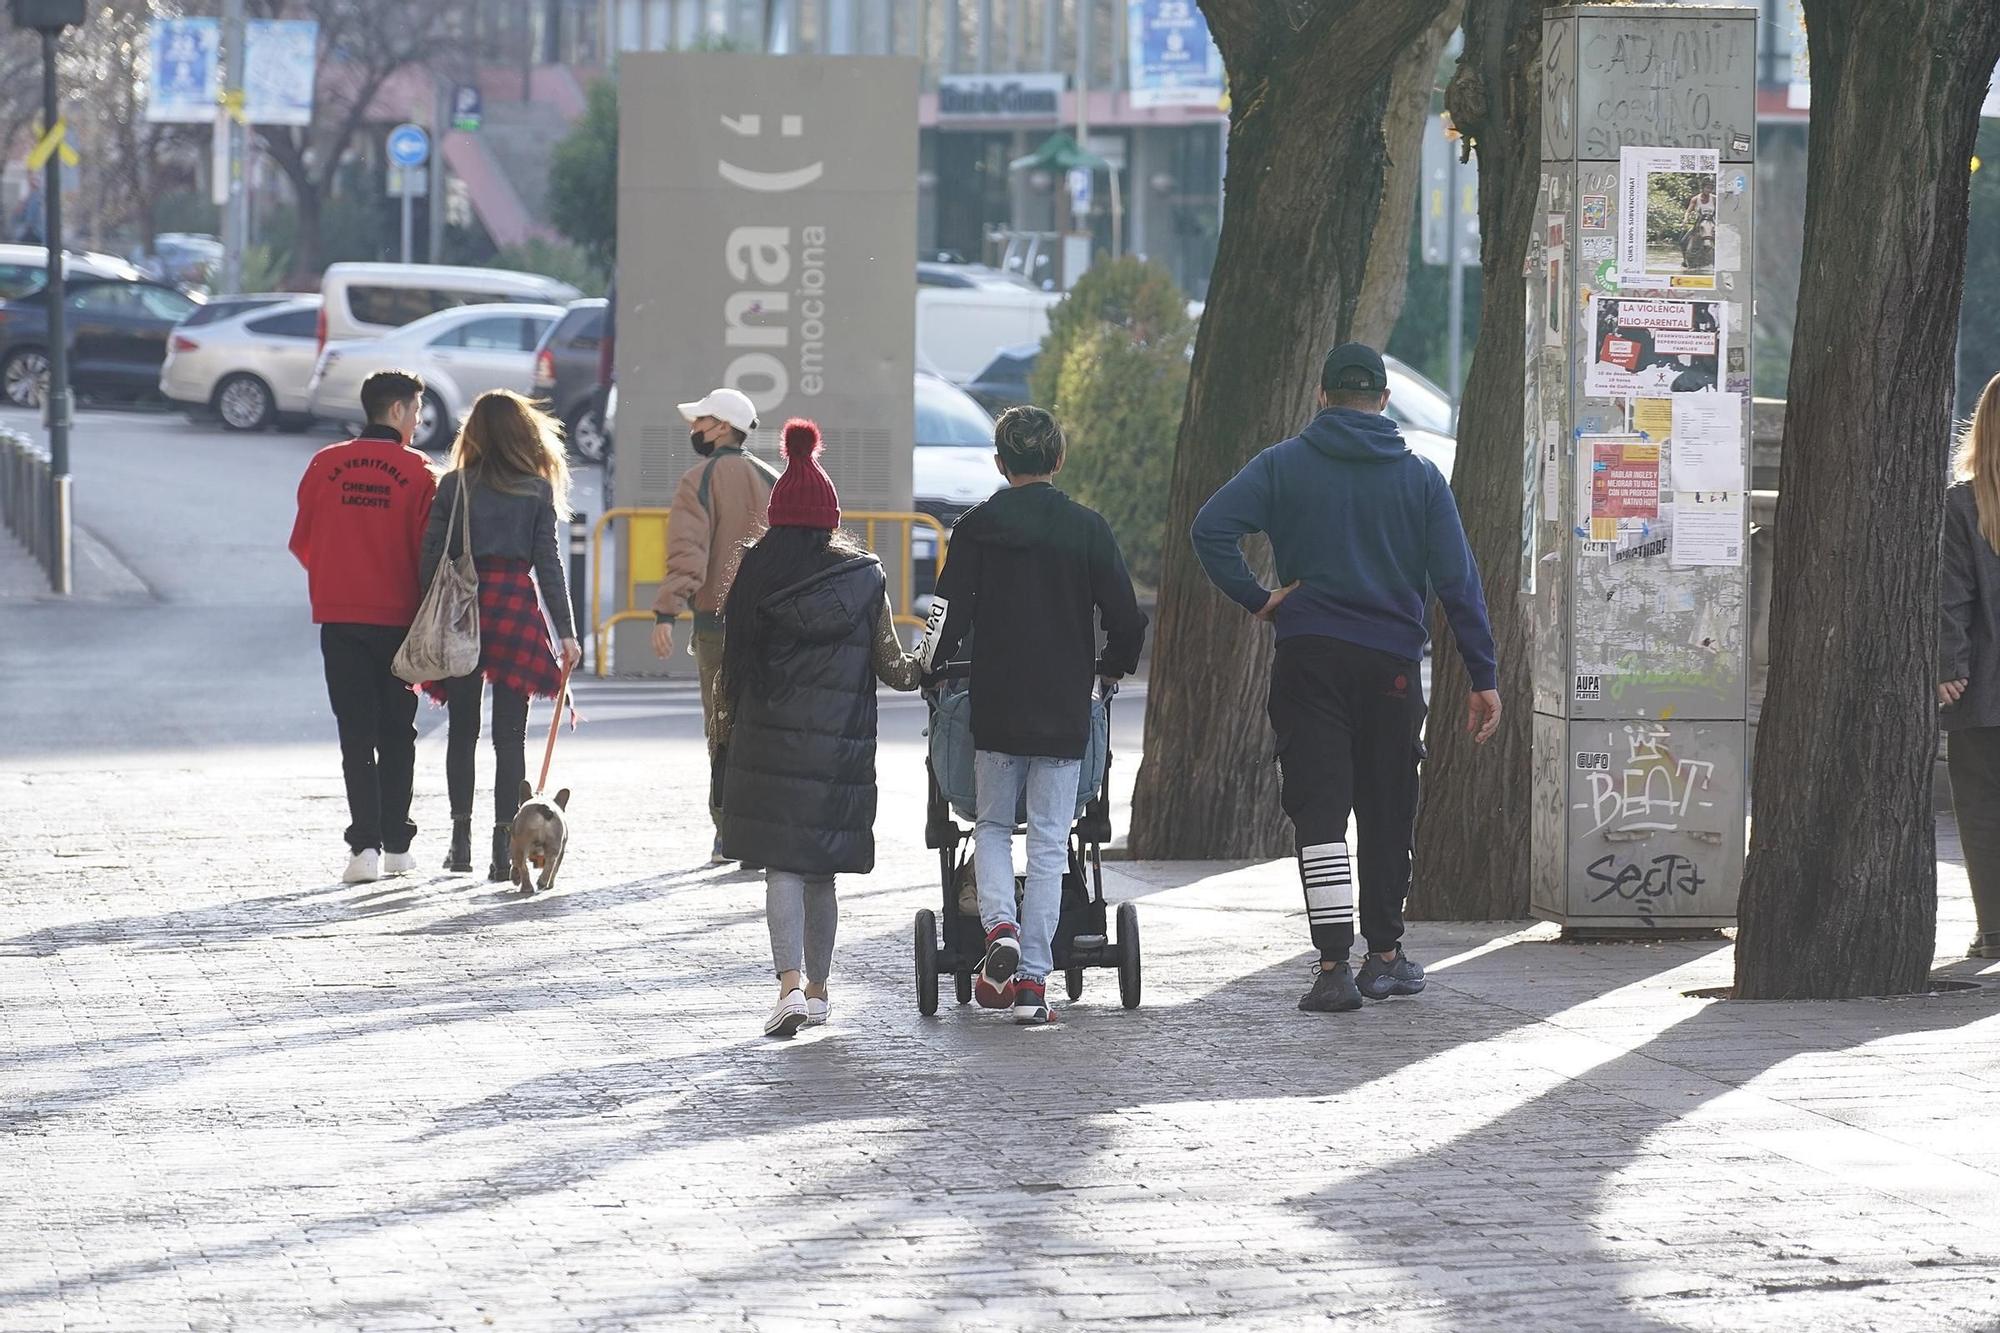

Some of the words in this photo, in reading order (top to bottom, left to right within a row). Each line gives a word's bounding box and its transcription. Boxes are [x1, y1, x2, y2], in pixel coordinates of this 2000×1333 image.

[795, 225, 826, 396] emociona
[1623, 304, 1637, 313] LA
[1638, 304, 1686, 314] VIOLENCIA
[1618, 317, 1690, 328] FILIO-PARENTAL
[328, 467, 343, 482] LA
[344, 458, 409, 488] VERITABLE
[342, 482, 391, 496] CHEMISE
[341, 496, 390, 509] LACOSTE
[1576, 675, 1600, 691] AUPA
[1576, 753, 1610, 769] GUFO
